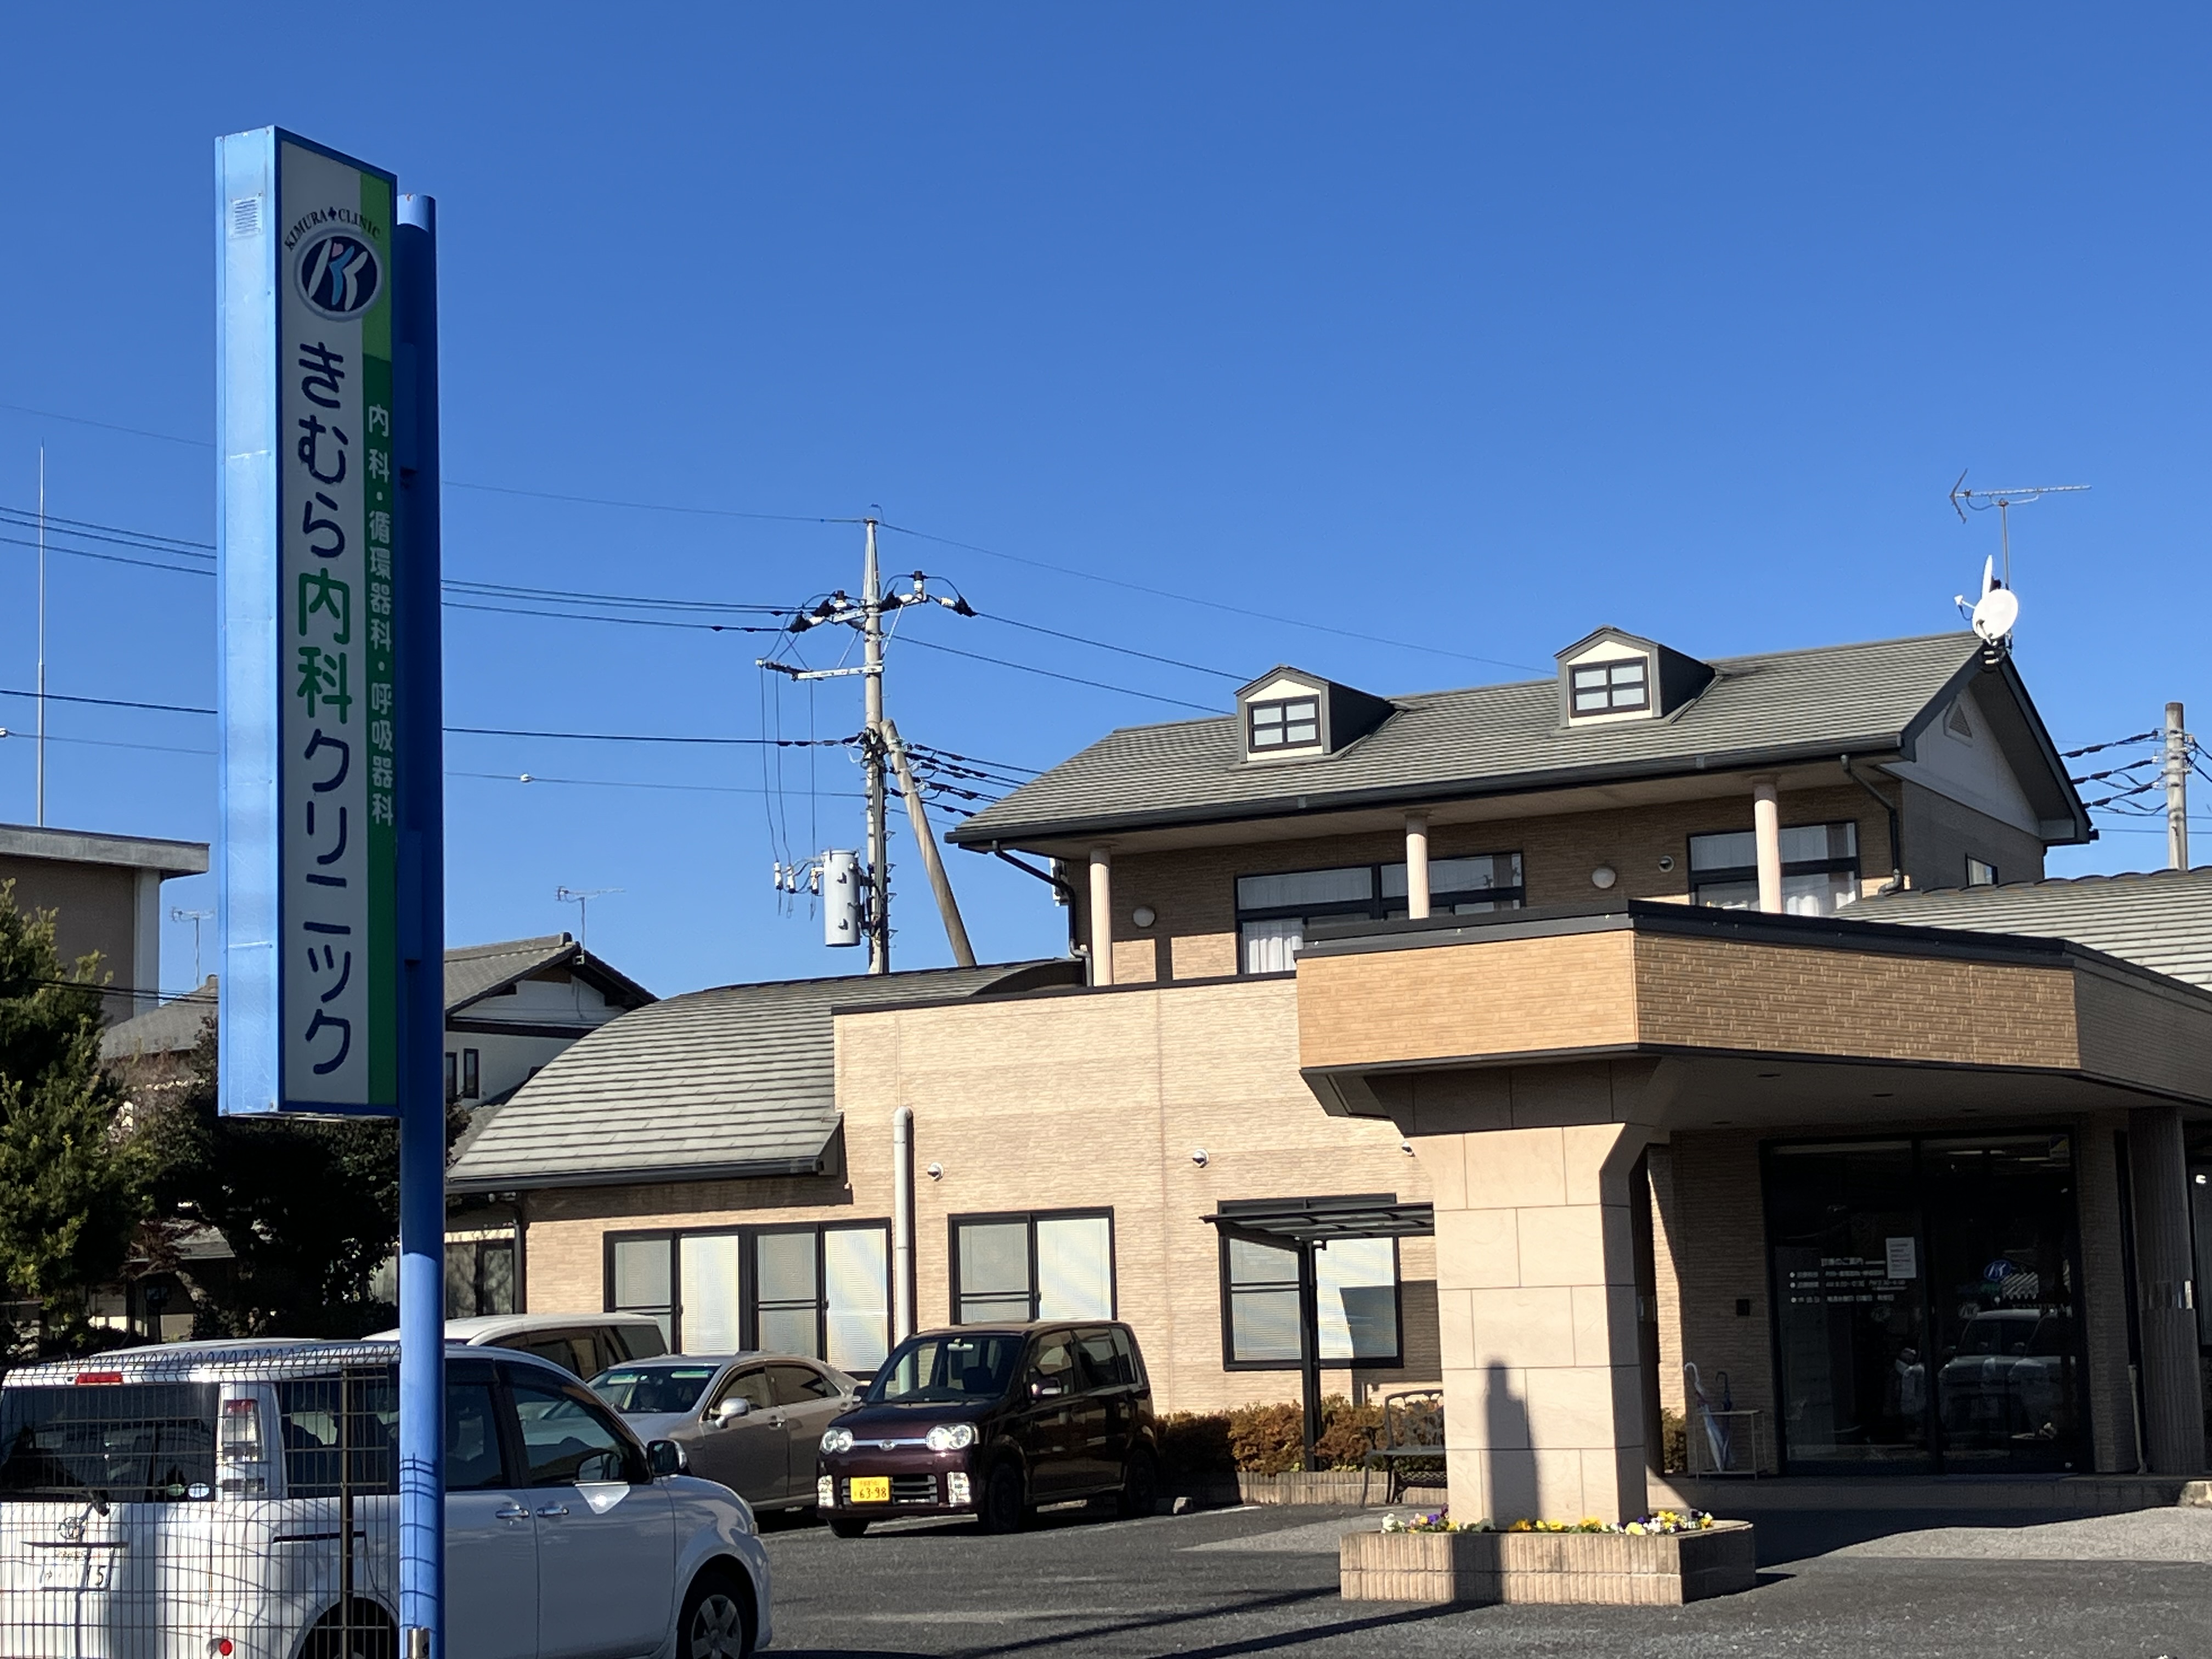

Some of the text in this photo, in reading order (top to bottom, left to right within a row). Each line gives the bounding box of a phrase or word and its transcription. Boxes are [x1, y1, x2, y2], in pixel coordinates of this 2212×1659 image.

[284, 208, 381, 252] KIMURA CLINIC
[297, 341, 352, 1075] きむら内科クリニック
[368, 403, 393, 827] 内科・循環器科・呼吸器科
[859, 1487, 887, 1499] 63-98
